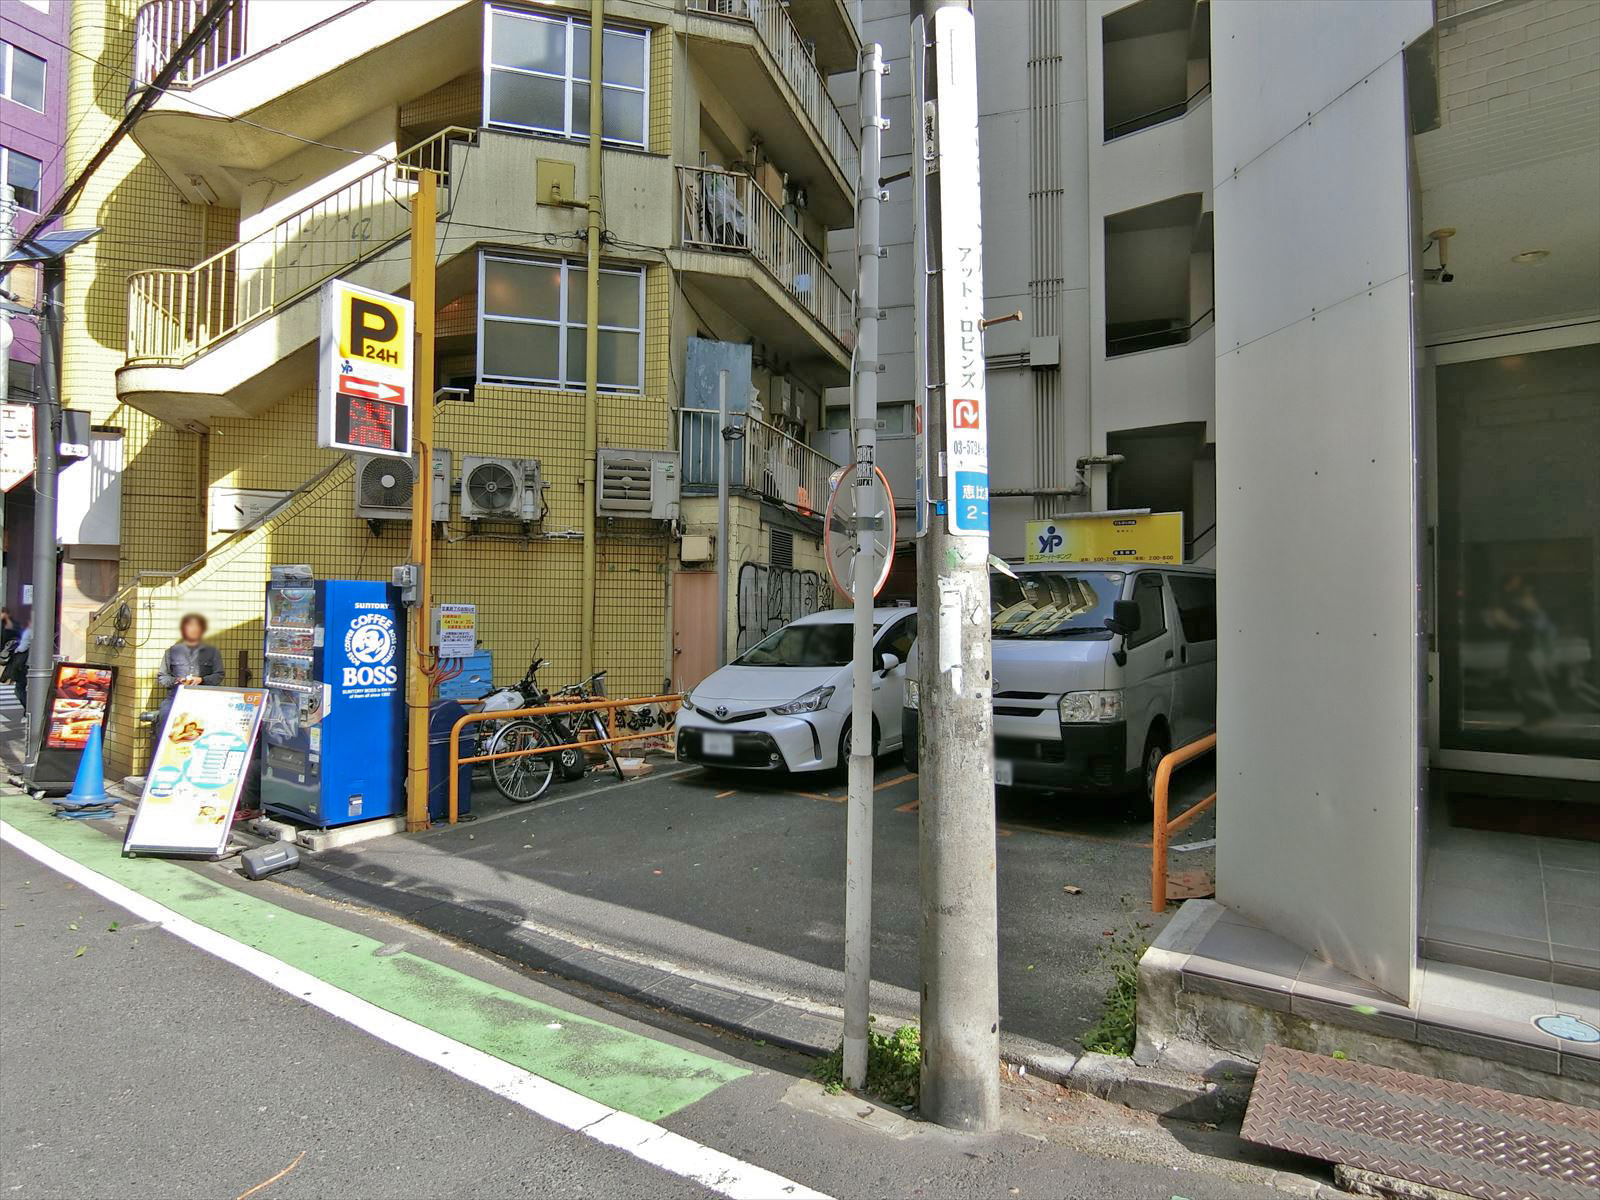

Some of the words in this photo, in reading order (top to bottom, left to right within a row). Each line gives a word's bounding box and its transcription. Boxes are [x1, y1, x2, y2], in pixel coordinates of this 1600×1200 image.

[350, 297, 398, 357] P
[957, 245, 976, 390] アット・ロビンズ
[365, 344, 398, 364] 24H
[351, 614, 393, 630] COFFEE
[342, 665, 398, 687] BOSS
